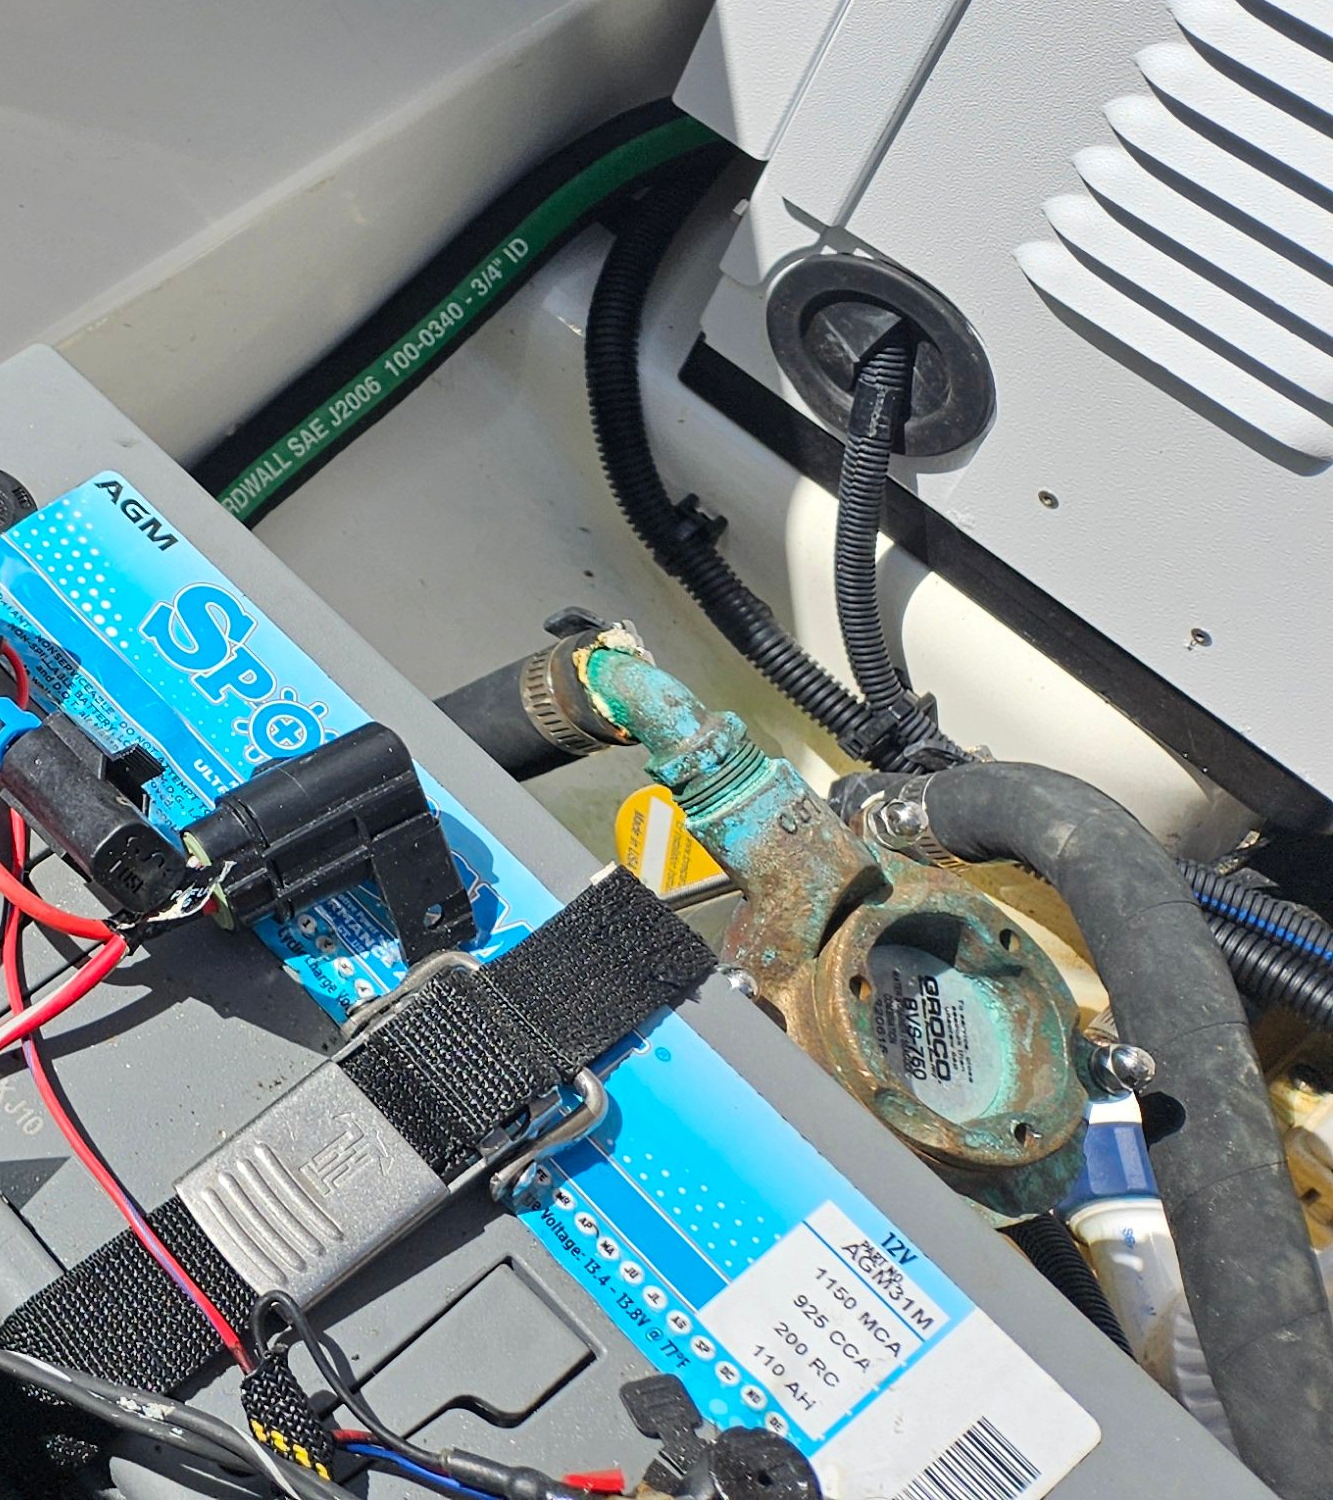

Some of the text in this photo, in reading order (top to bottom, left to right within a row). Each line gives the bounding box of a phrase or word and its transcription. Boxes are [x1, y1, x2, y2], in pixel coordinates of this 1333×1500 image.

[286, 417, 329, 458] SAE
[328, 375, 382, 427] J2006
[383, 301, 465, 378] 100-0340
[503, 237, 530, 263] ID
[94, 476, 179, 552] AGM
[34, 663, 54, 683] and
[298, 953, 341, 996] Charge
[575, 1213, 595, 1233] AP
[597, 1238, 617, 1258] MA
[857, 1238, 889, 1268] PART
[878, 1230, 919, 1270] 12V
[538, 1208, 585, 1262] Voltage:
[580, 1255, 613, 1288] 13.4
[613, 1291, 653, 1331] 13.8V
[642, 1322, 666, 1347] @
[809, 1264, 907, 1359] 1150 MCA
[840, 1240, 936, 1331] AGM31M
[770, 1319, 843, 1391] 200 RC
[789, 1291, 875, 1375] 925 CCA
[748, 1341, 818, 1413] 110 AH
